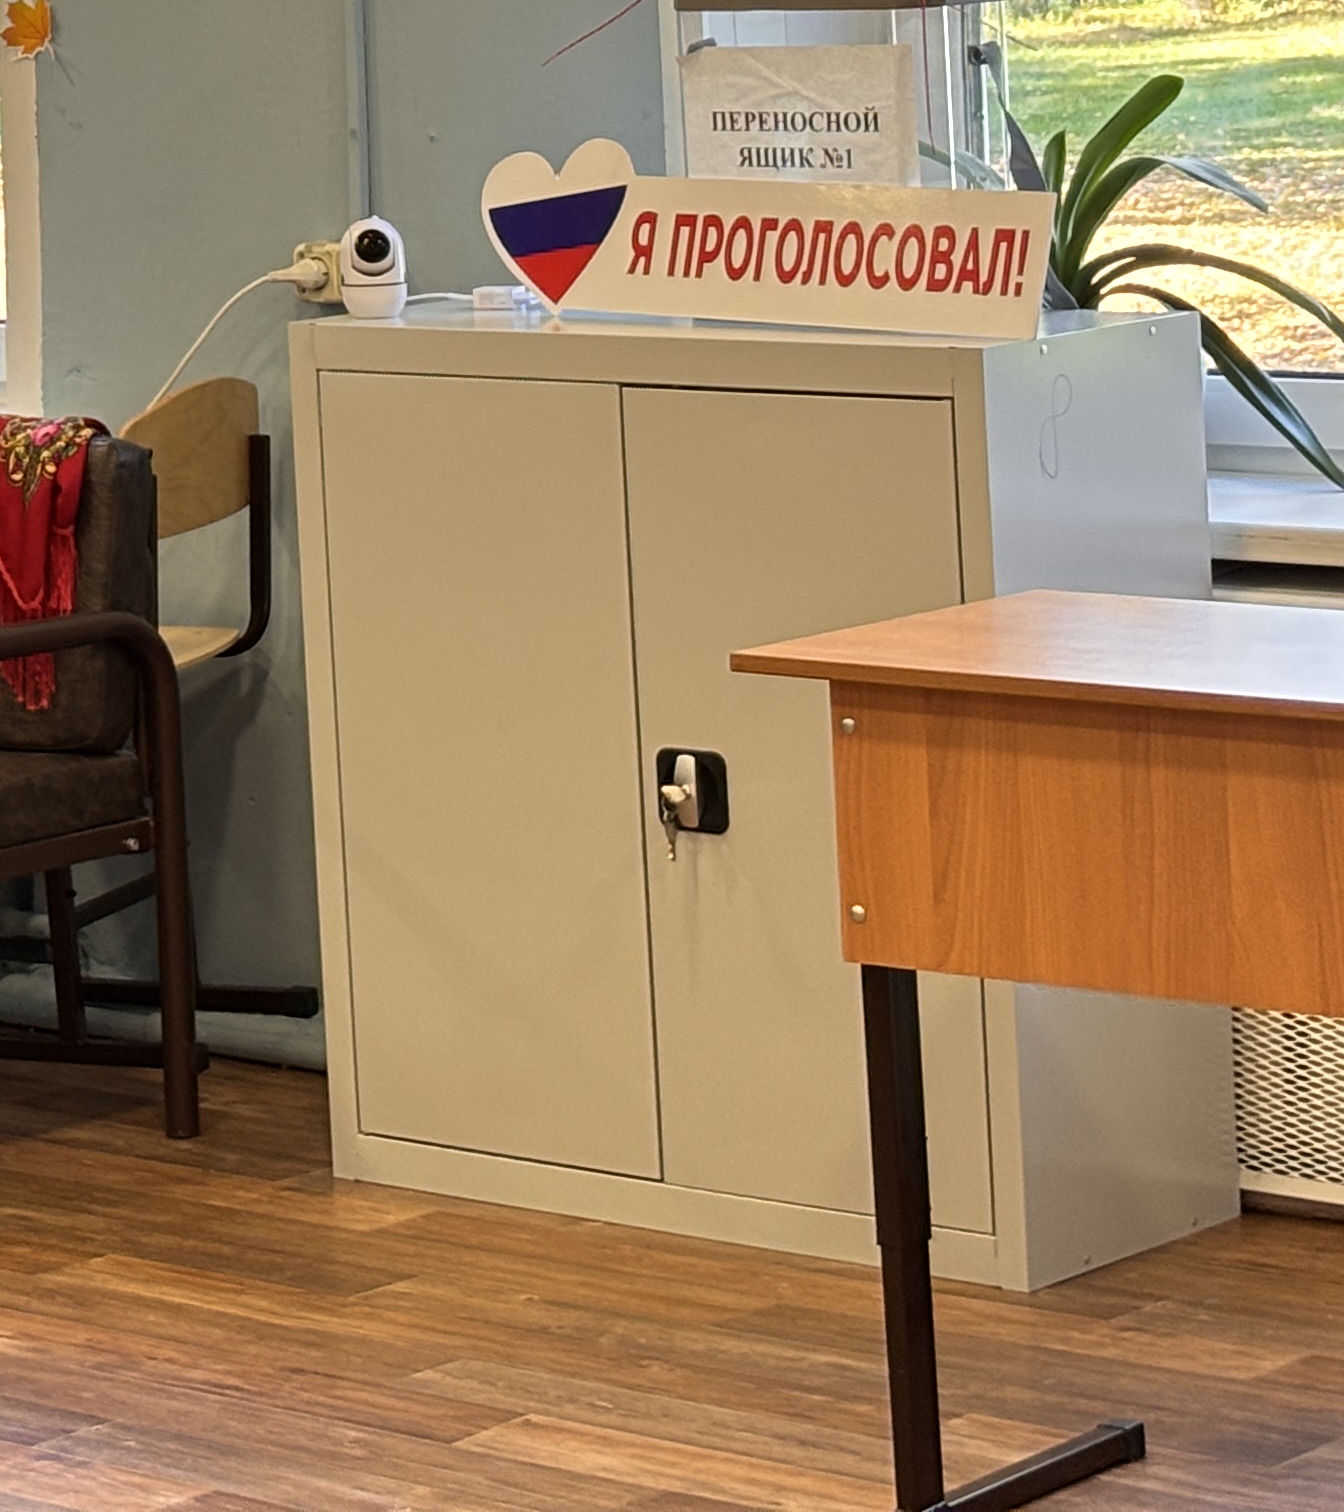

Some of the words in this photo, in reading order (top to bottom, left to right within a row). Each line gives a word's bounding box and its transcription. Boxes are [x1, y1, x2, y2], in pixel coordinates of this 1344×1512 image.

[712, 105, 880, 133] ПЕРЕНОСНОЙ
[738, 146, 815, 172] ЯЩИК
[820, 147, 853, 169] №1
[627, 211, 659, 276] Я
[667, 214, 1030, 298] ПРОГОЛОСОВАЛ!
